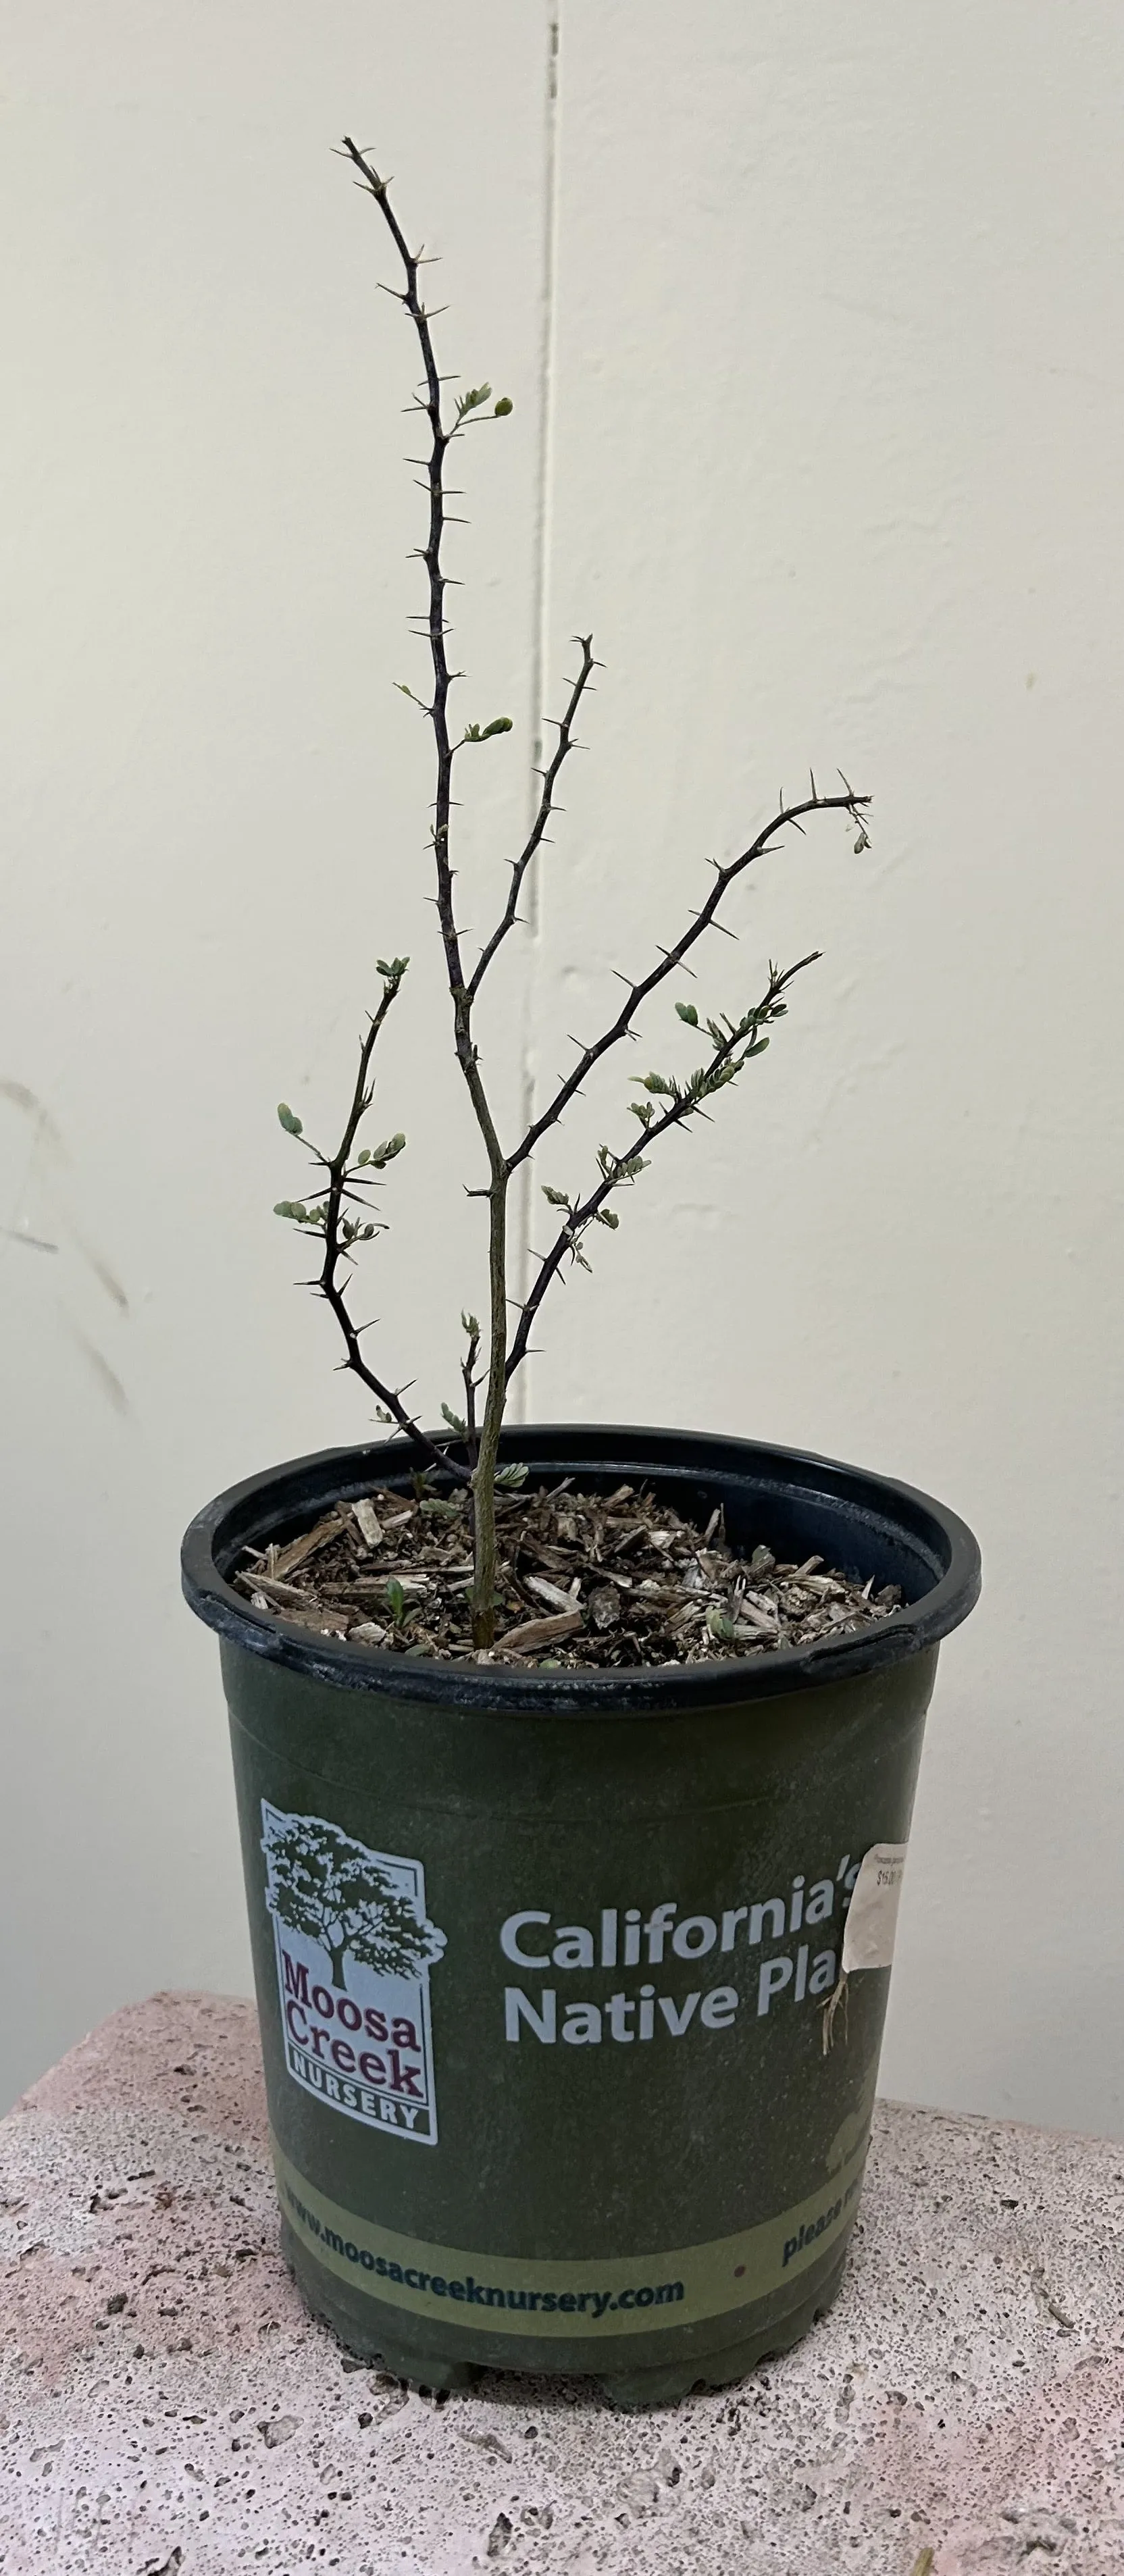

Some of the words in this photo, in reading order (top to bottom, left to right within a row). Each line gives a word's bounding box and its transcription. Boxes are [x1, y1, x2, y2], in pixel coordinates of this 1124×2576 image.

[282, 1951, 422, 2053] Moosa
[504, 1984, 739, 2044] Native
[757, 1943, 836, 2017] Pla
[286, 1999, 424, 2098] Creek
[292, 2048, 419, 2129] NURSERY
[284, 2180, 685, 2319] www.moosacreeknursery.com
[782, 2198, 842, 2267] please
